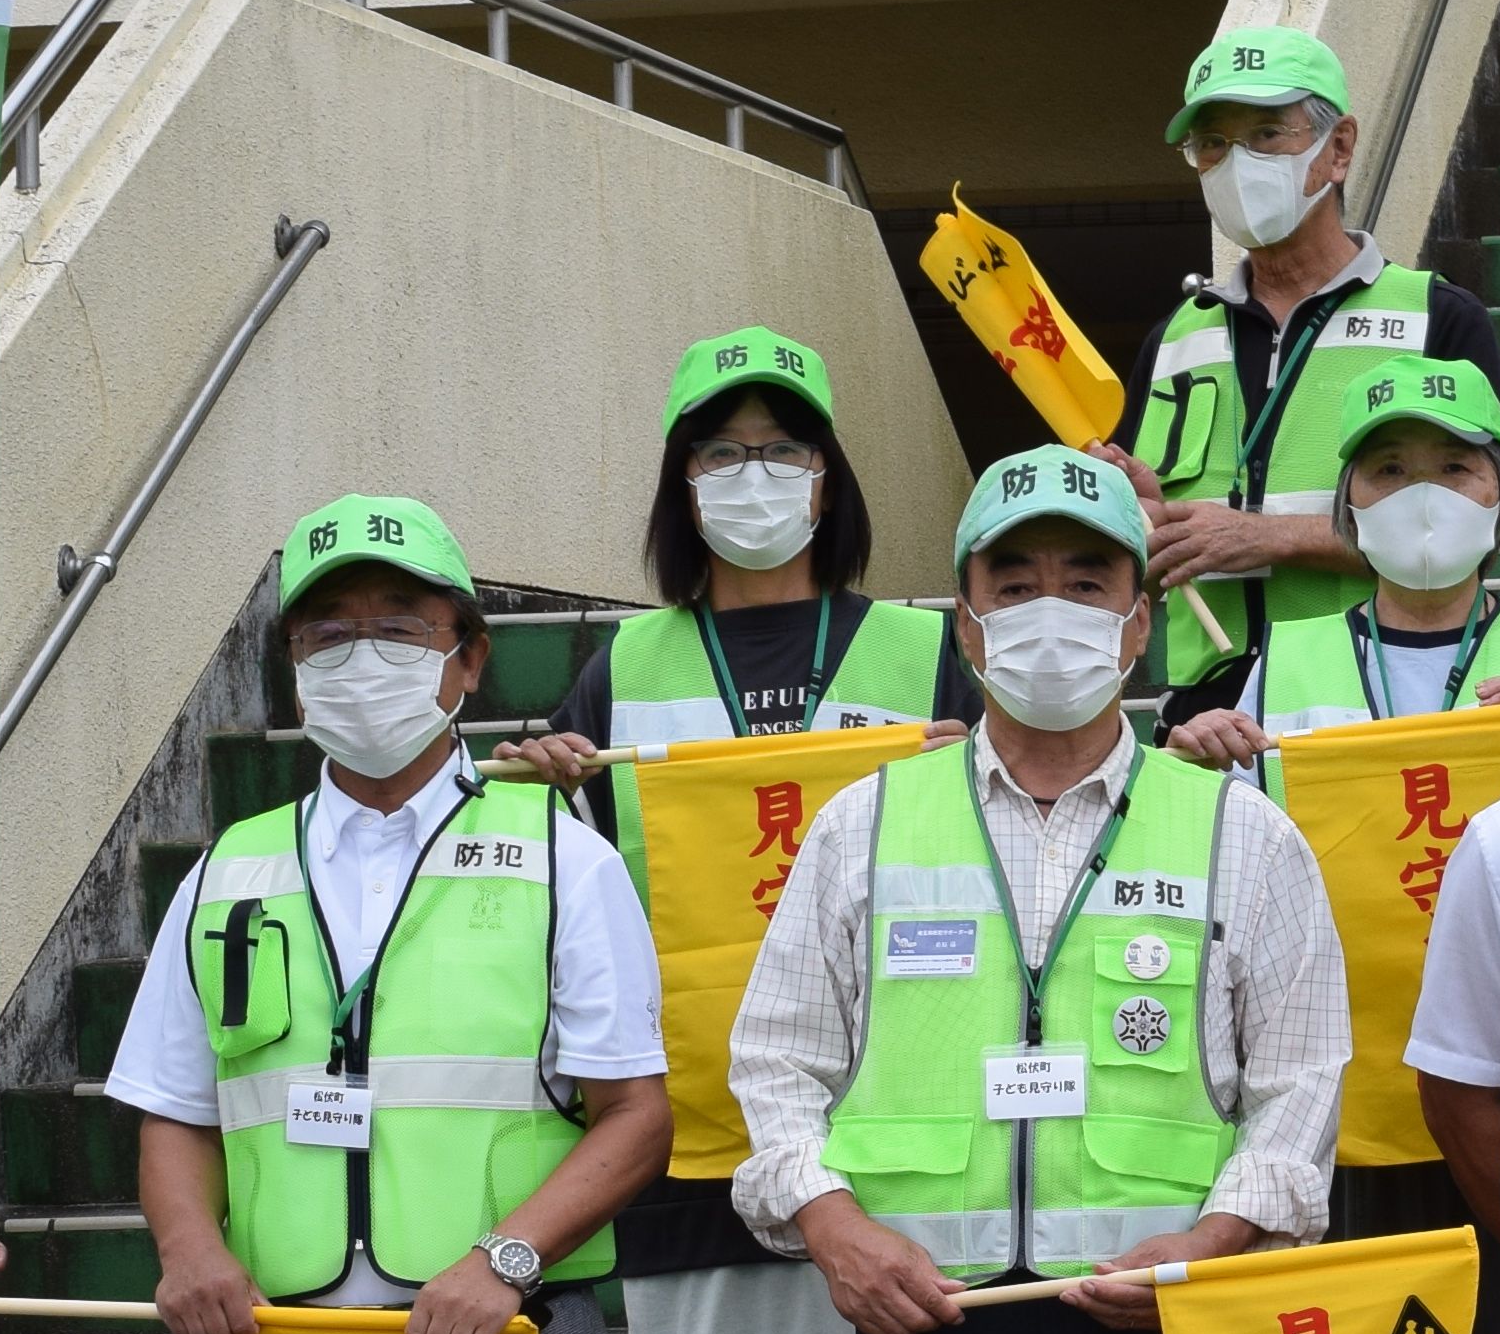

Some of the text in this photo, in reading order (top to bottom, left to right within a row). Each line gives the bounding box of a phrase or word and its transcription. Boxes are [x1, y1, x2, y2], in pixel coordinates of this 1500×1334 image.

[1194, 47, 1265, 91] 防犯
[1345, 316, 1405, 339] 防犯
[715, 344, 806, 378] 防犯
[1367, 375, 1457, 412] 防犯
[1001, 461, 1100, 504] 防犯
[309, 514, 405, 560] 防犯
[454, 842, 523, 868] 防犯
[1114, 879, 1185, 908] 防犯
[1016, 1061, 1051, 1074] 松伏町
[314, 1090, 345, 1104] 松伏町
[993, 1080, 1076, 1096] 子ども見守り隊
[292, 1108, 363, 1125] 子ども見守り隊
